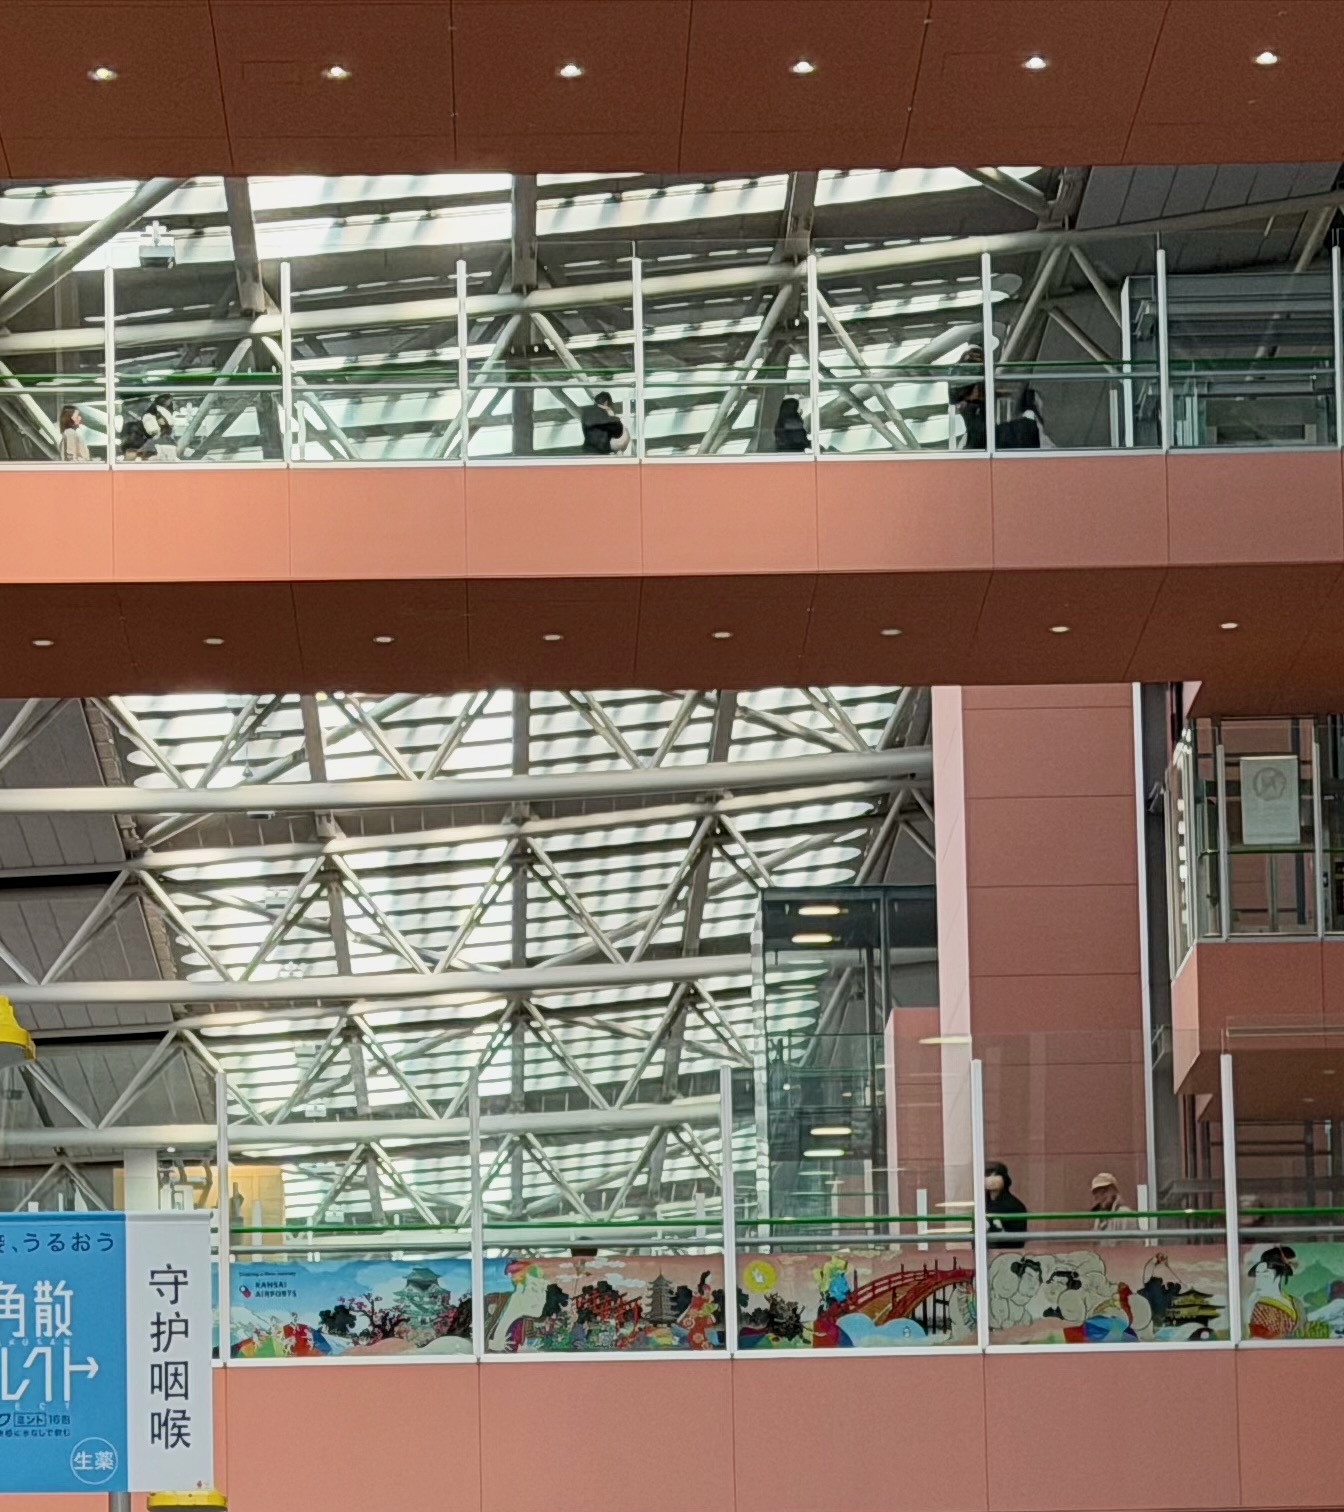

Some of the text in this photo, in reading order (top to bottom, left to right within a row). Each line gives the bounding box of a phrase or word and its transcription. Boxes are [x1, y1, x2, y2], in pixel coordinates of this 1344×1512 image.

[149, 1264, 191, 1450] 守护咽喉
[17, 1415, 44, 1425] ミント
